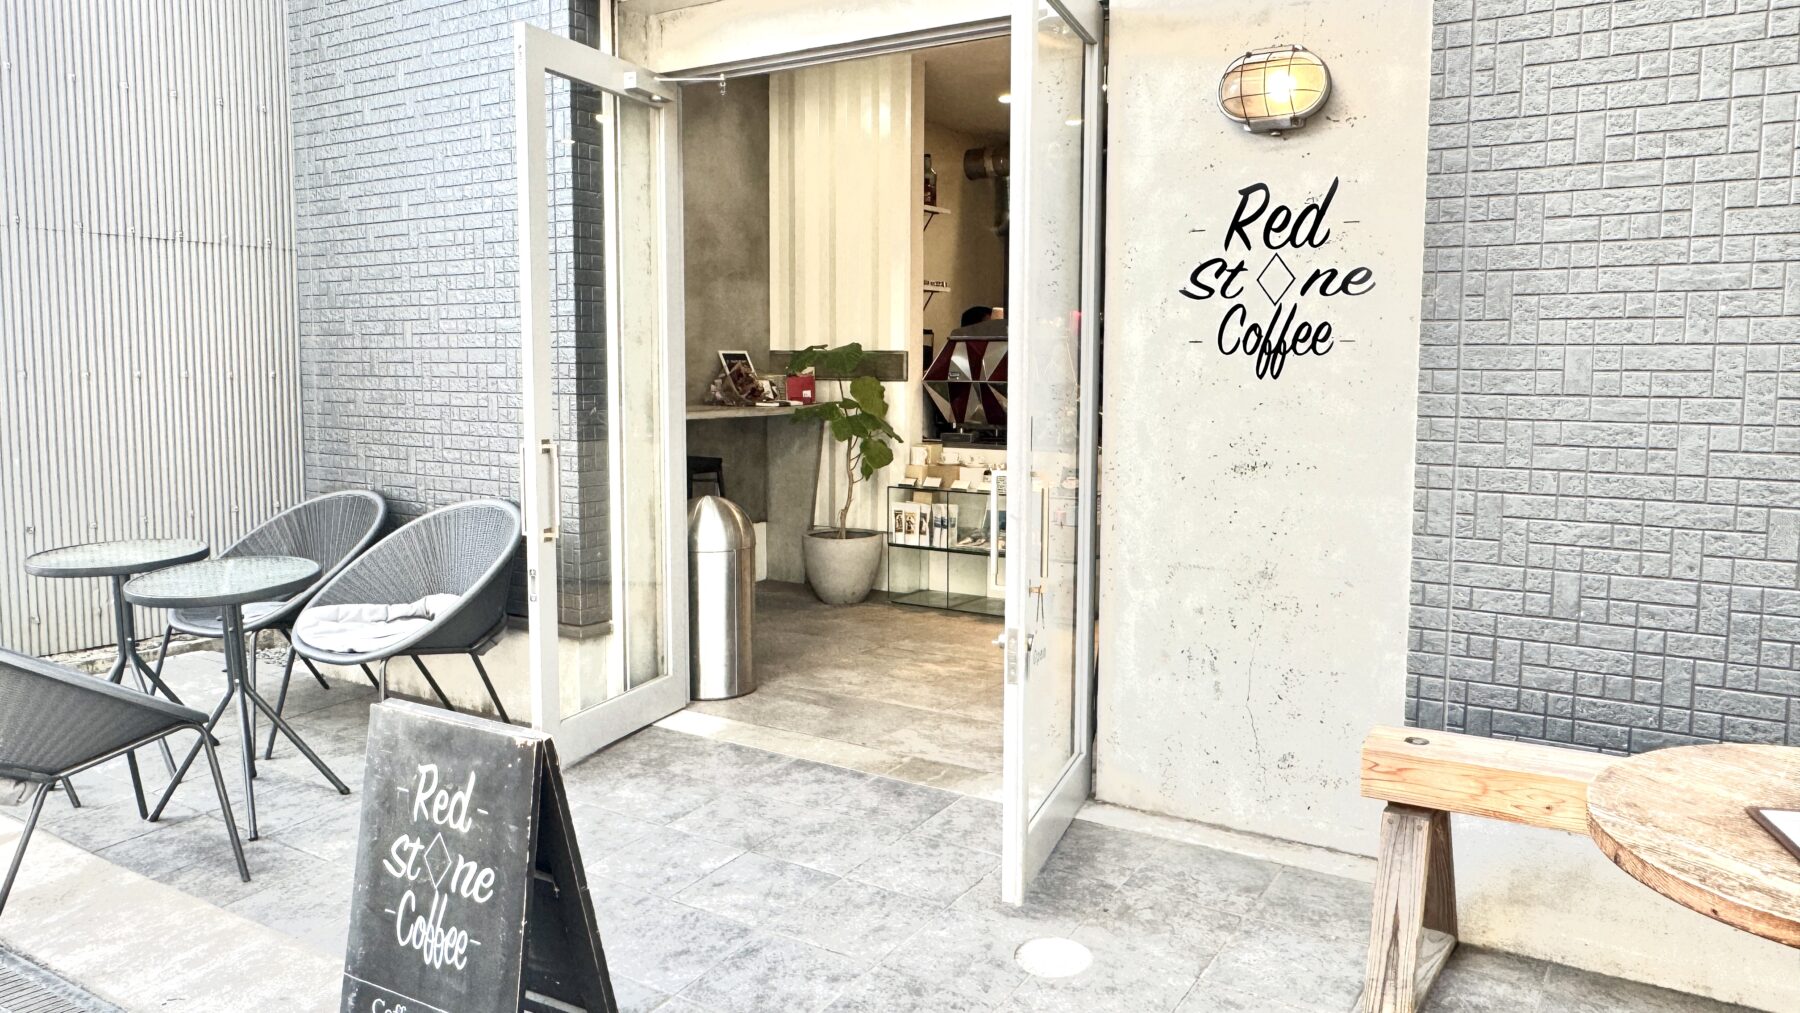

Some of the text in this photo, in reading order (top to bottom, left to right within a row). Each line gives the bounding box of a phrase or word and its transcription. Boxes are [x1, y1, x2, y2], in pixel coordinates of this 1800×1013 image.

[1224, 176, 1339, 251] Red
[1217, 302, 1334, 380] Coffee
[413, 763, 476, 833] Red
[396, 888, 468, 970] Coffee
